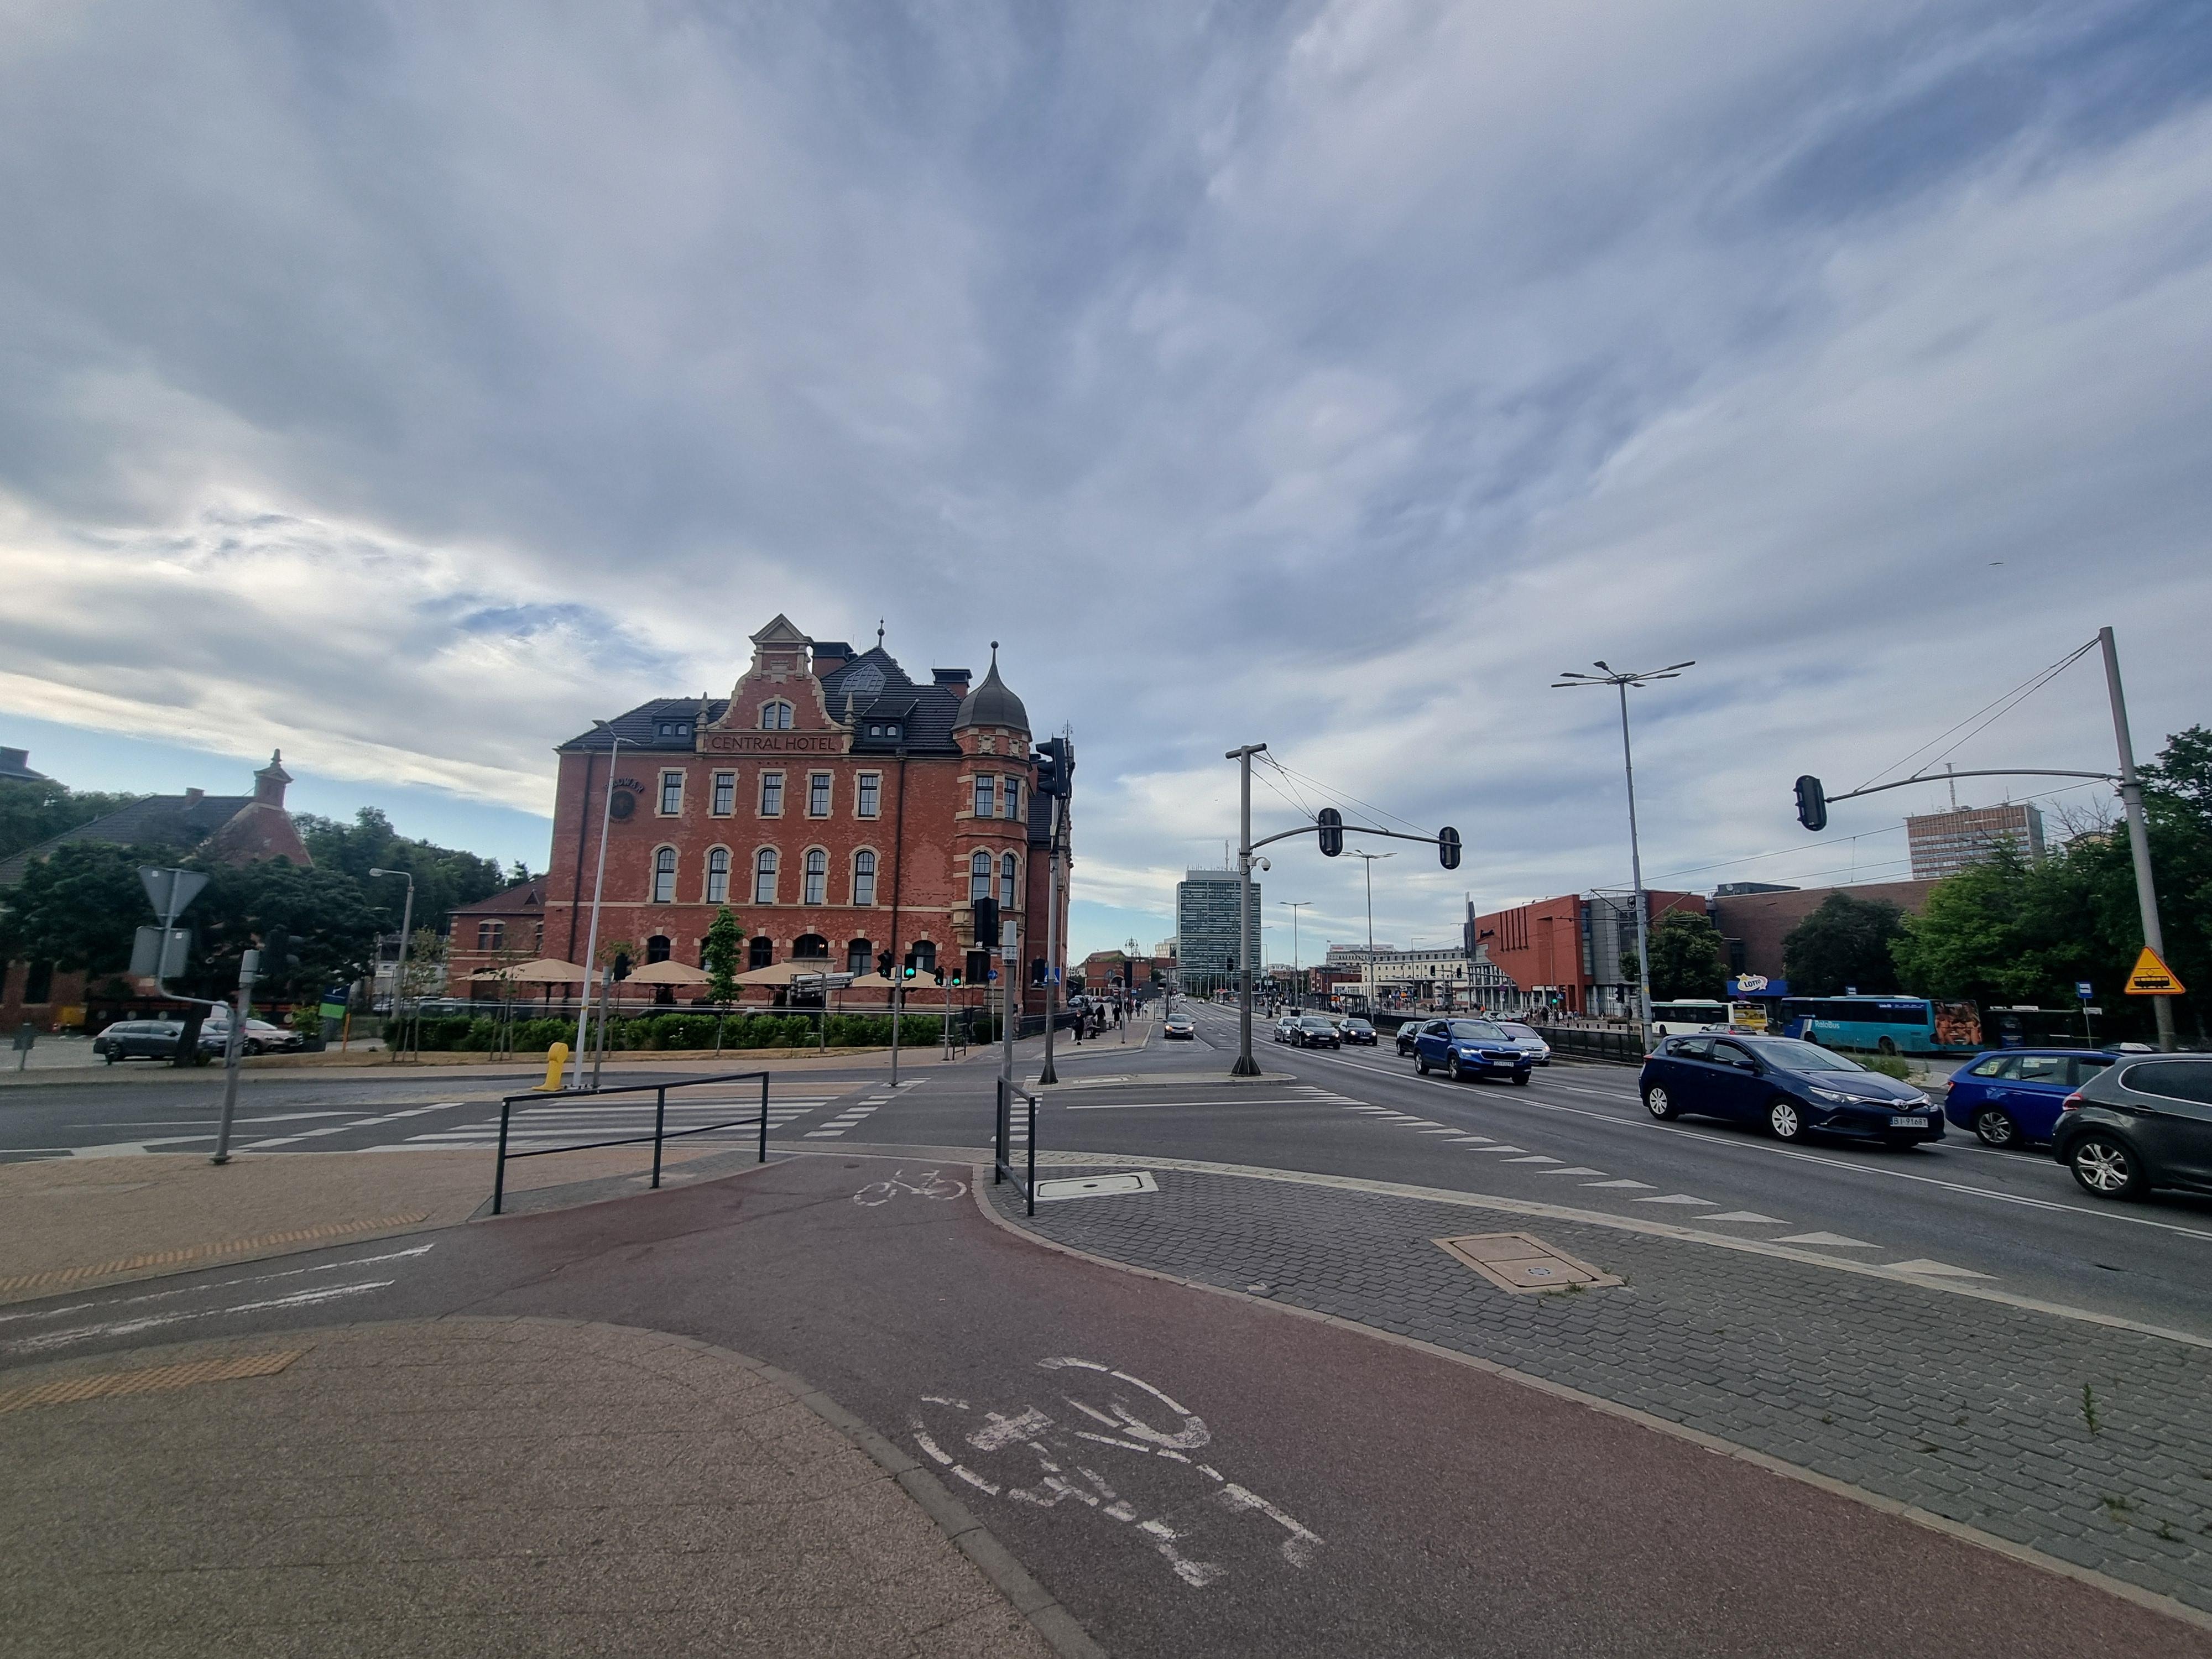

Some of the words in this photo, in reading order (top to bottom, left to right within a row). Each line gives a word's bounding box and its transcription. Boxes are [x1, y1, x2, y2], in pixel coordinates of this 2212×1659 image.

[712, 737, 781, 750] CENTRAL
[786, 737, 836, 750] HOTEL
[1744, 979, 1761, 988] LOTTO
